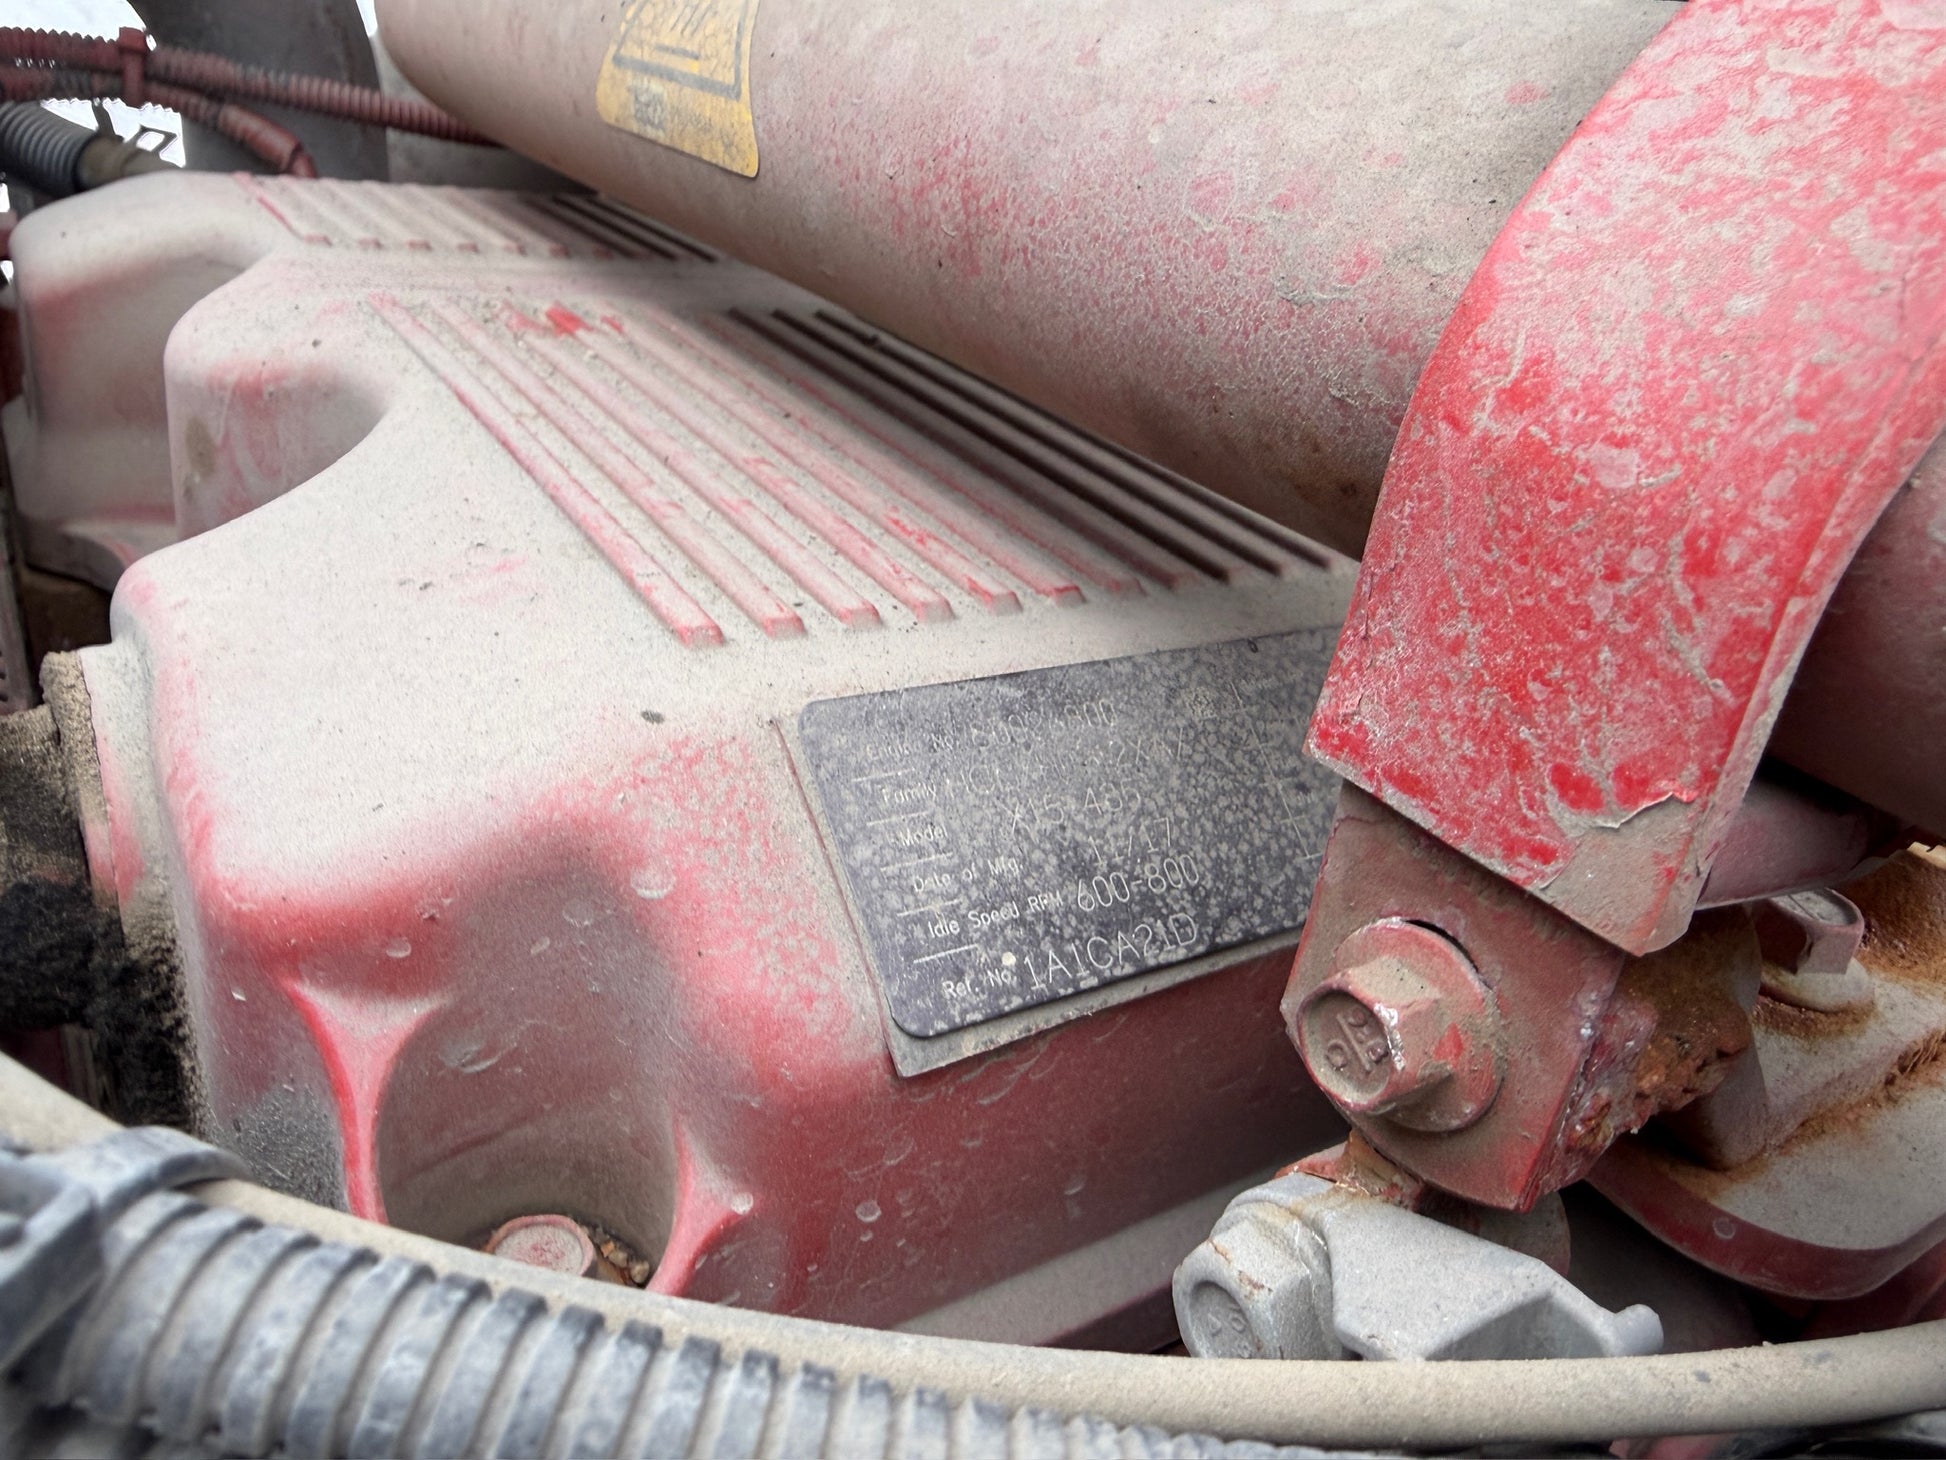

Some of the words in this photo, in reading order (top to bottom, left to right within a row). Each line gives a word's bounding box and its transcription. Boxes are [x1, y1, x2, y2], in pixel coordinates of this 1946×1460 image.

[880, 778, 937, 805] Family
[899, 825, 949, 847] Model
[961, 861, 978, 882] of
[986, 856, 1024, 878] Mfg.
[928, 915, 961, 939] Idle
[967, 900, 1021, 930] Speed
[1027, 890, 1064, 913] RPM
[1077, 853, 1200, 912] 600-800
[941, 974, 980, 999] Ref.
[986, 968, 1018, 988] No.
[1023, 912, 1198, 991] 1A1CA21D
